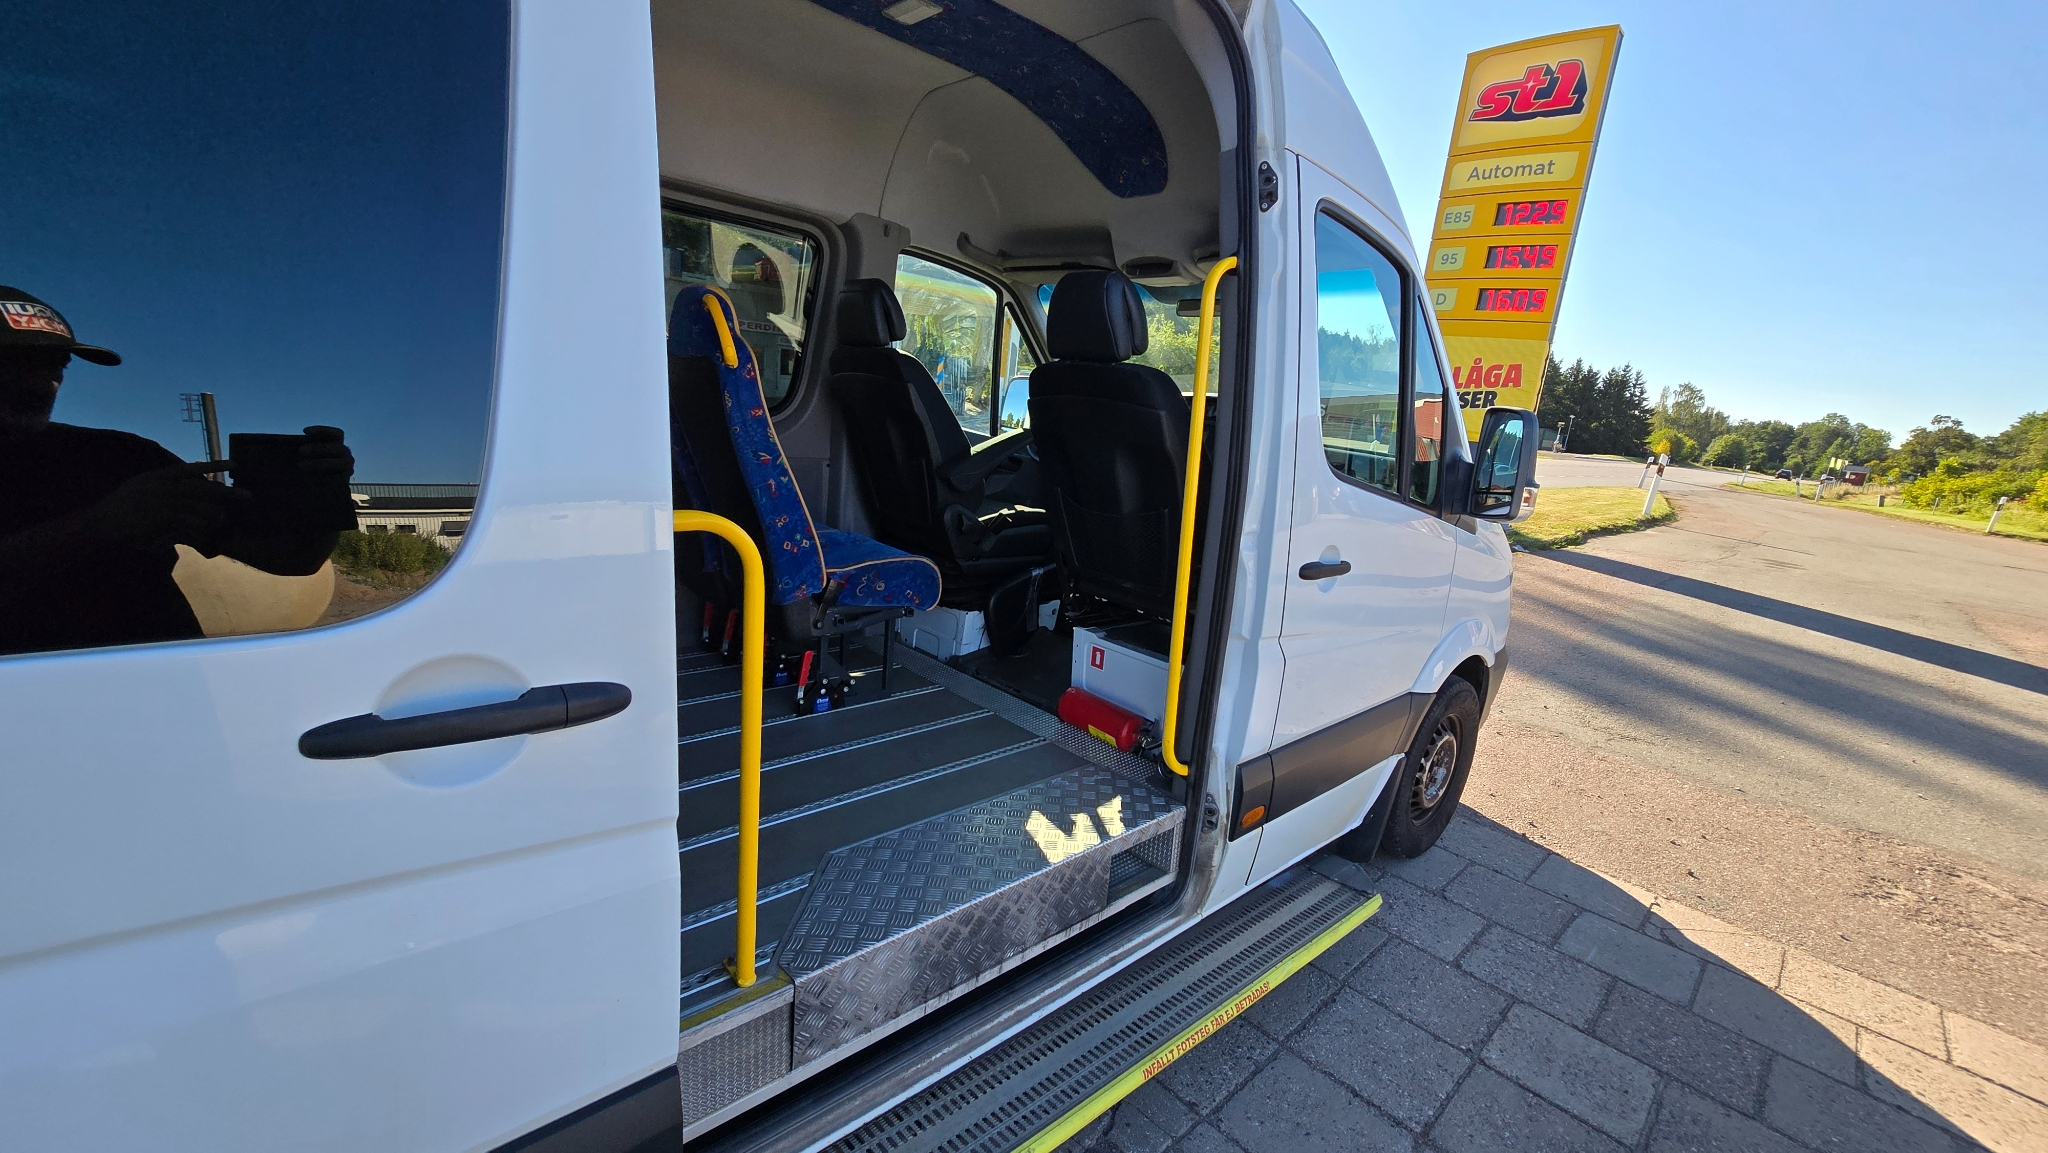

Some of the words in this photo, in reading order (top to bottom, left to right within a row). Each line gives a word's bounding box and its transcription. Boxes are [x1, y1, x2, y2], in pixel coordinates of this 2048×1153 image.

[1468, 59, 1588, 122] st1
[1466, 159, 1556, 182] Automat
[1444, 210, 1472, 224] E85
[1440, 253, 1458, 265] 95
[1495, 245, 1557, 270] 15.49
[1435, 293, 1447, 305] D
[1486, 289, 1548, 314] 16.09
[1453, 357, 1523, 390] LÅGA
[1456, 390, 1498, 410] SER
[1142, 1048, 1175, 1081] INFÄLLT
[1175, 1024, 1211, 1057] FOTSTEG
[1210, 1014, 1226, 1031] FÅR
[1224, 1006, 1235, 1021] EJ
